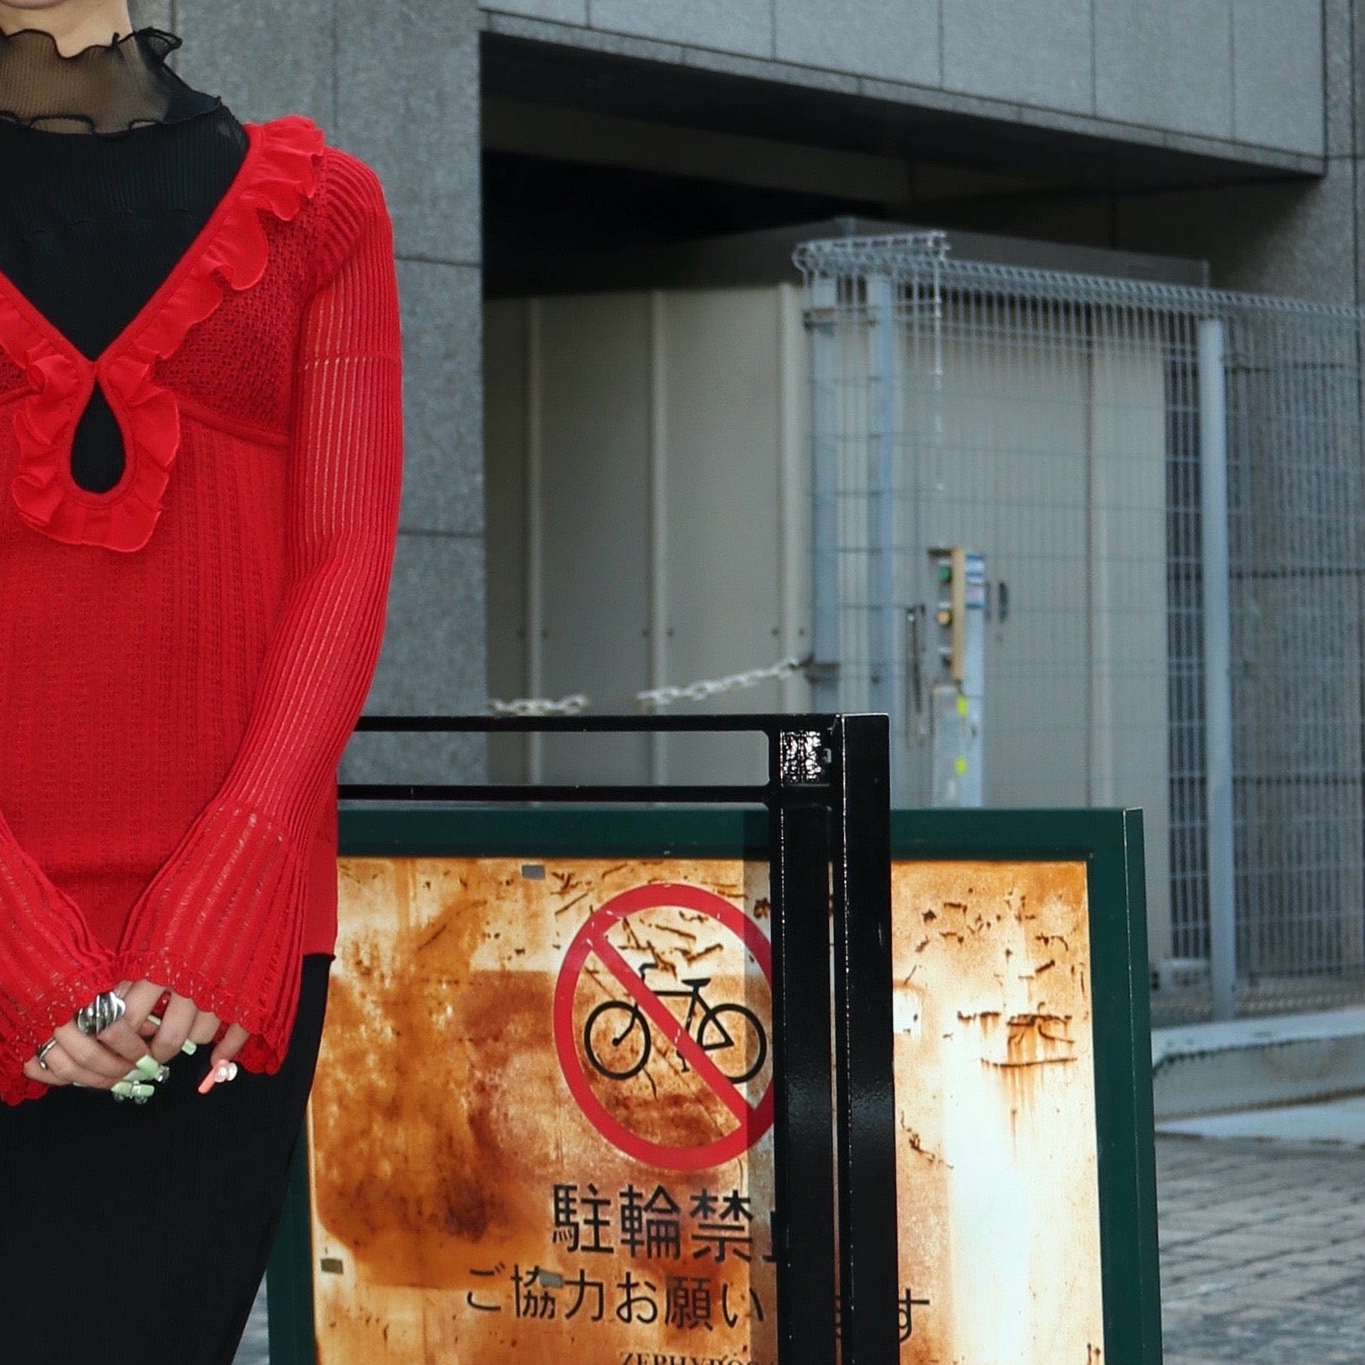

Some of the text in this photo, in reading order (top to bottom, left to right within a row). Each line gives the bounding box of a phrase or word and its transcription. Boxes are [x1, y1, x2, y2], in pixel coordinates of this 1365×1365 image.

[551, 1184, 777, 1263] 駐輪禁
[466, 1262, 931, 1343] ご協力お願いす
